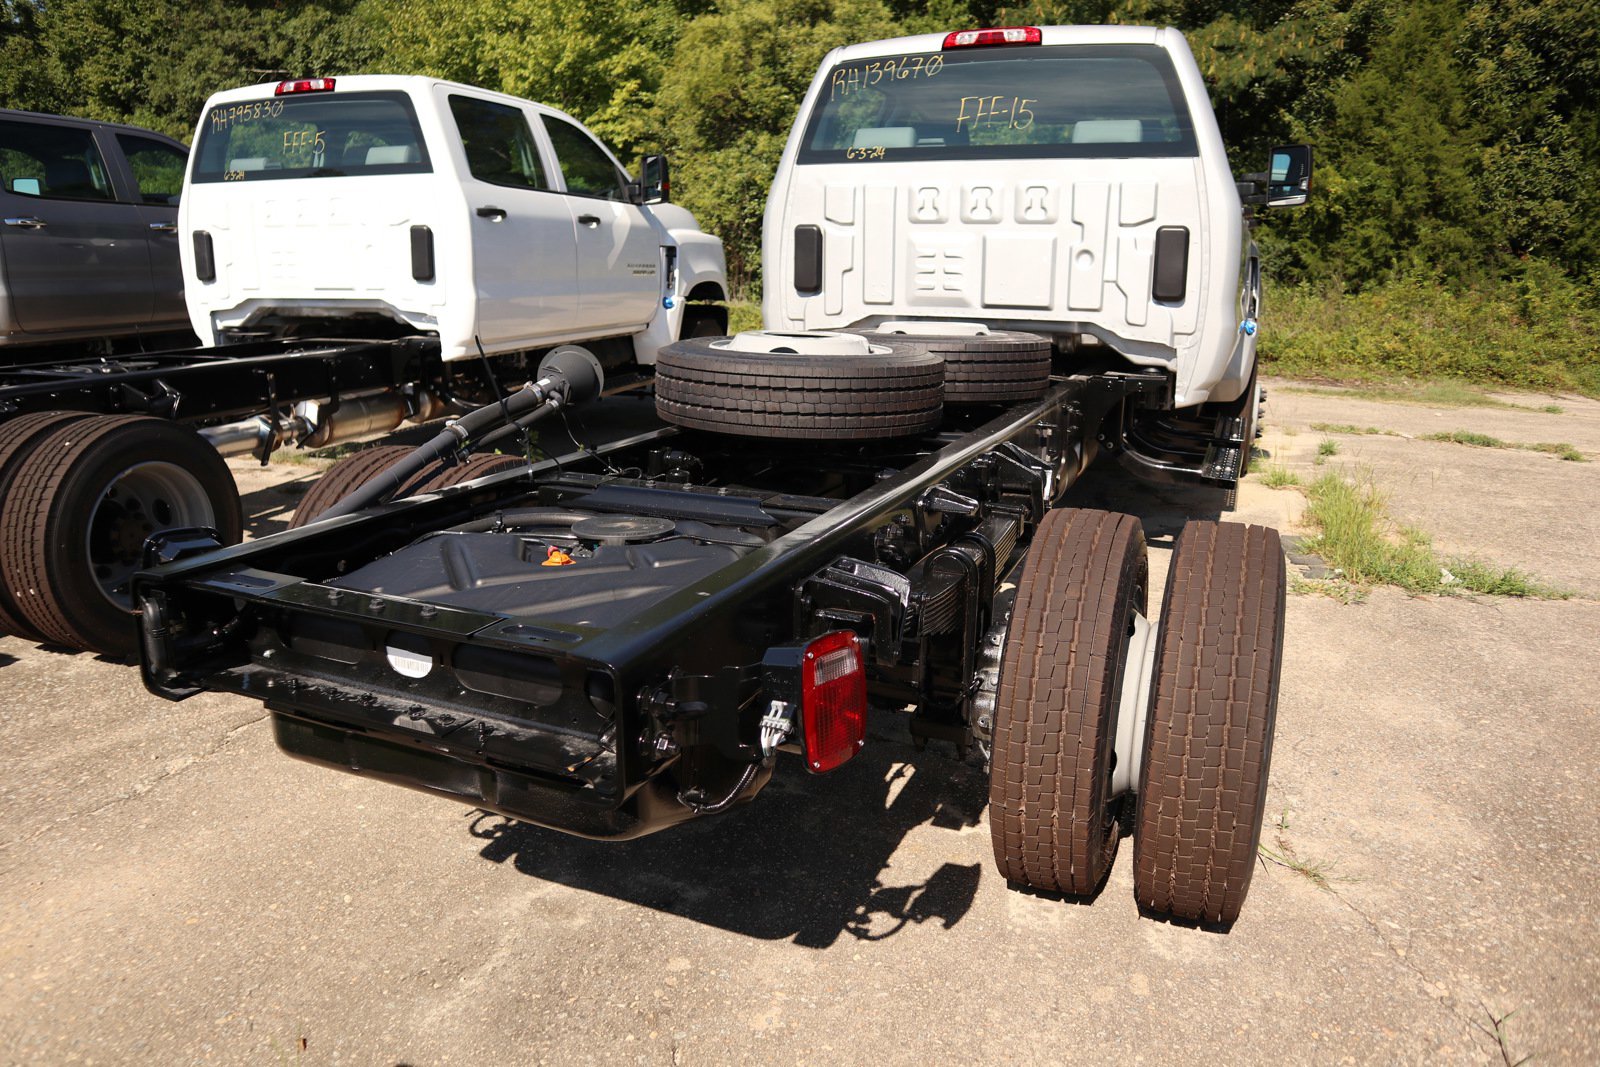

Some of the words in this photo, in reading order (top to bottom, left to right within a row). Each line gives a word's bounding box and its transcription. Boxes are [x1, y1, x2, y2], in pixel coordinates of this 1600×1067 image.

[956, 96, 1038, 133] FFF-15
[283, 131, 326, 154] FFF-5
[846, 146, 885, 160] 6-3-24
